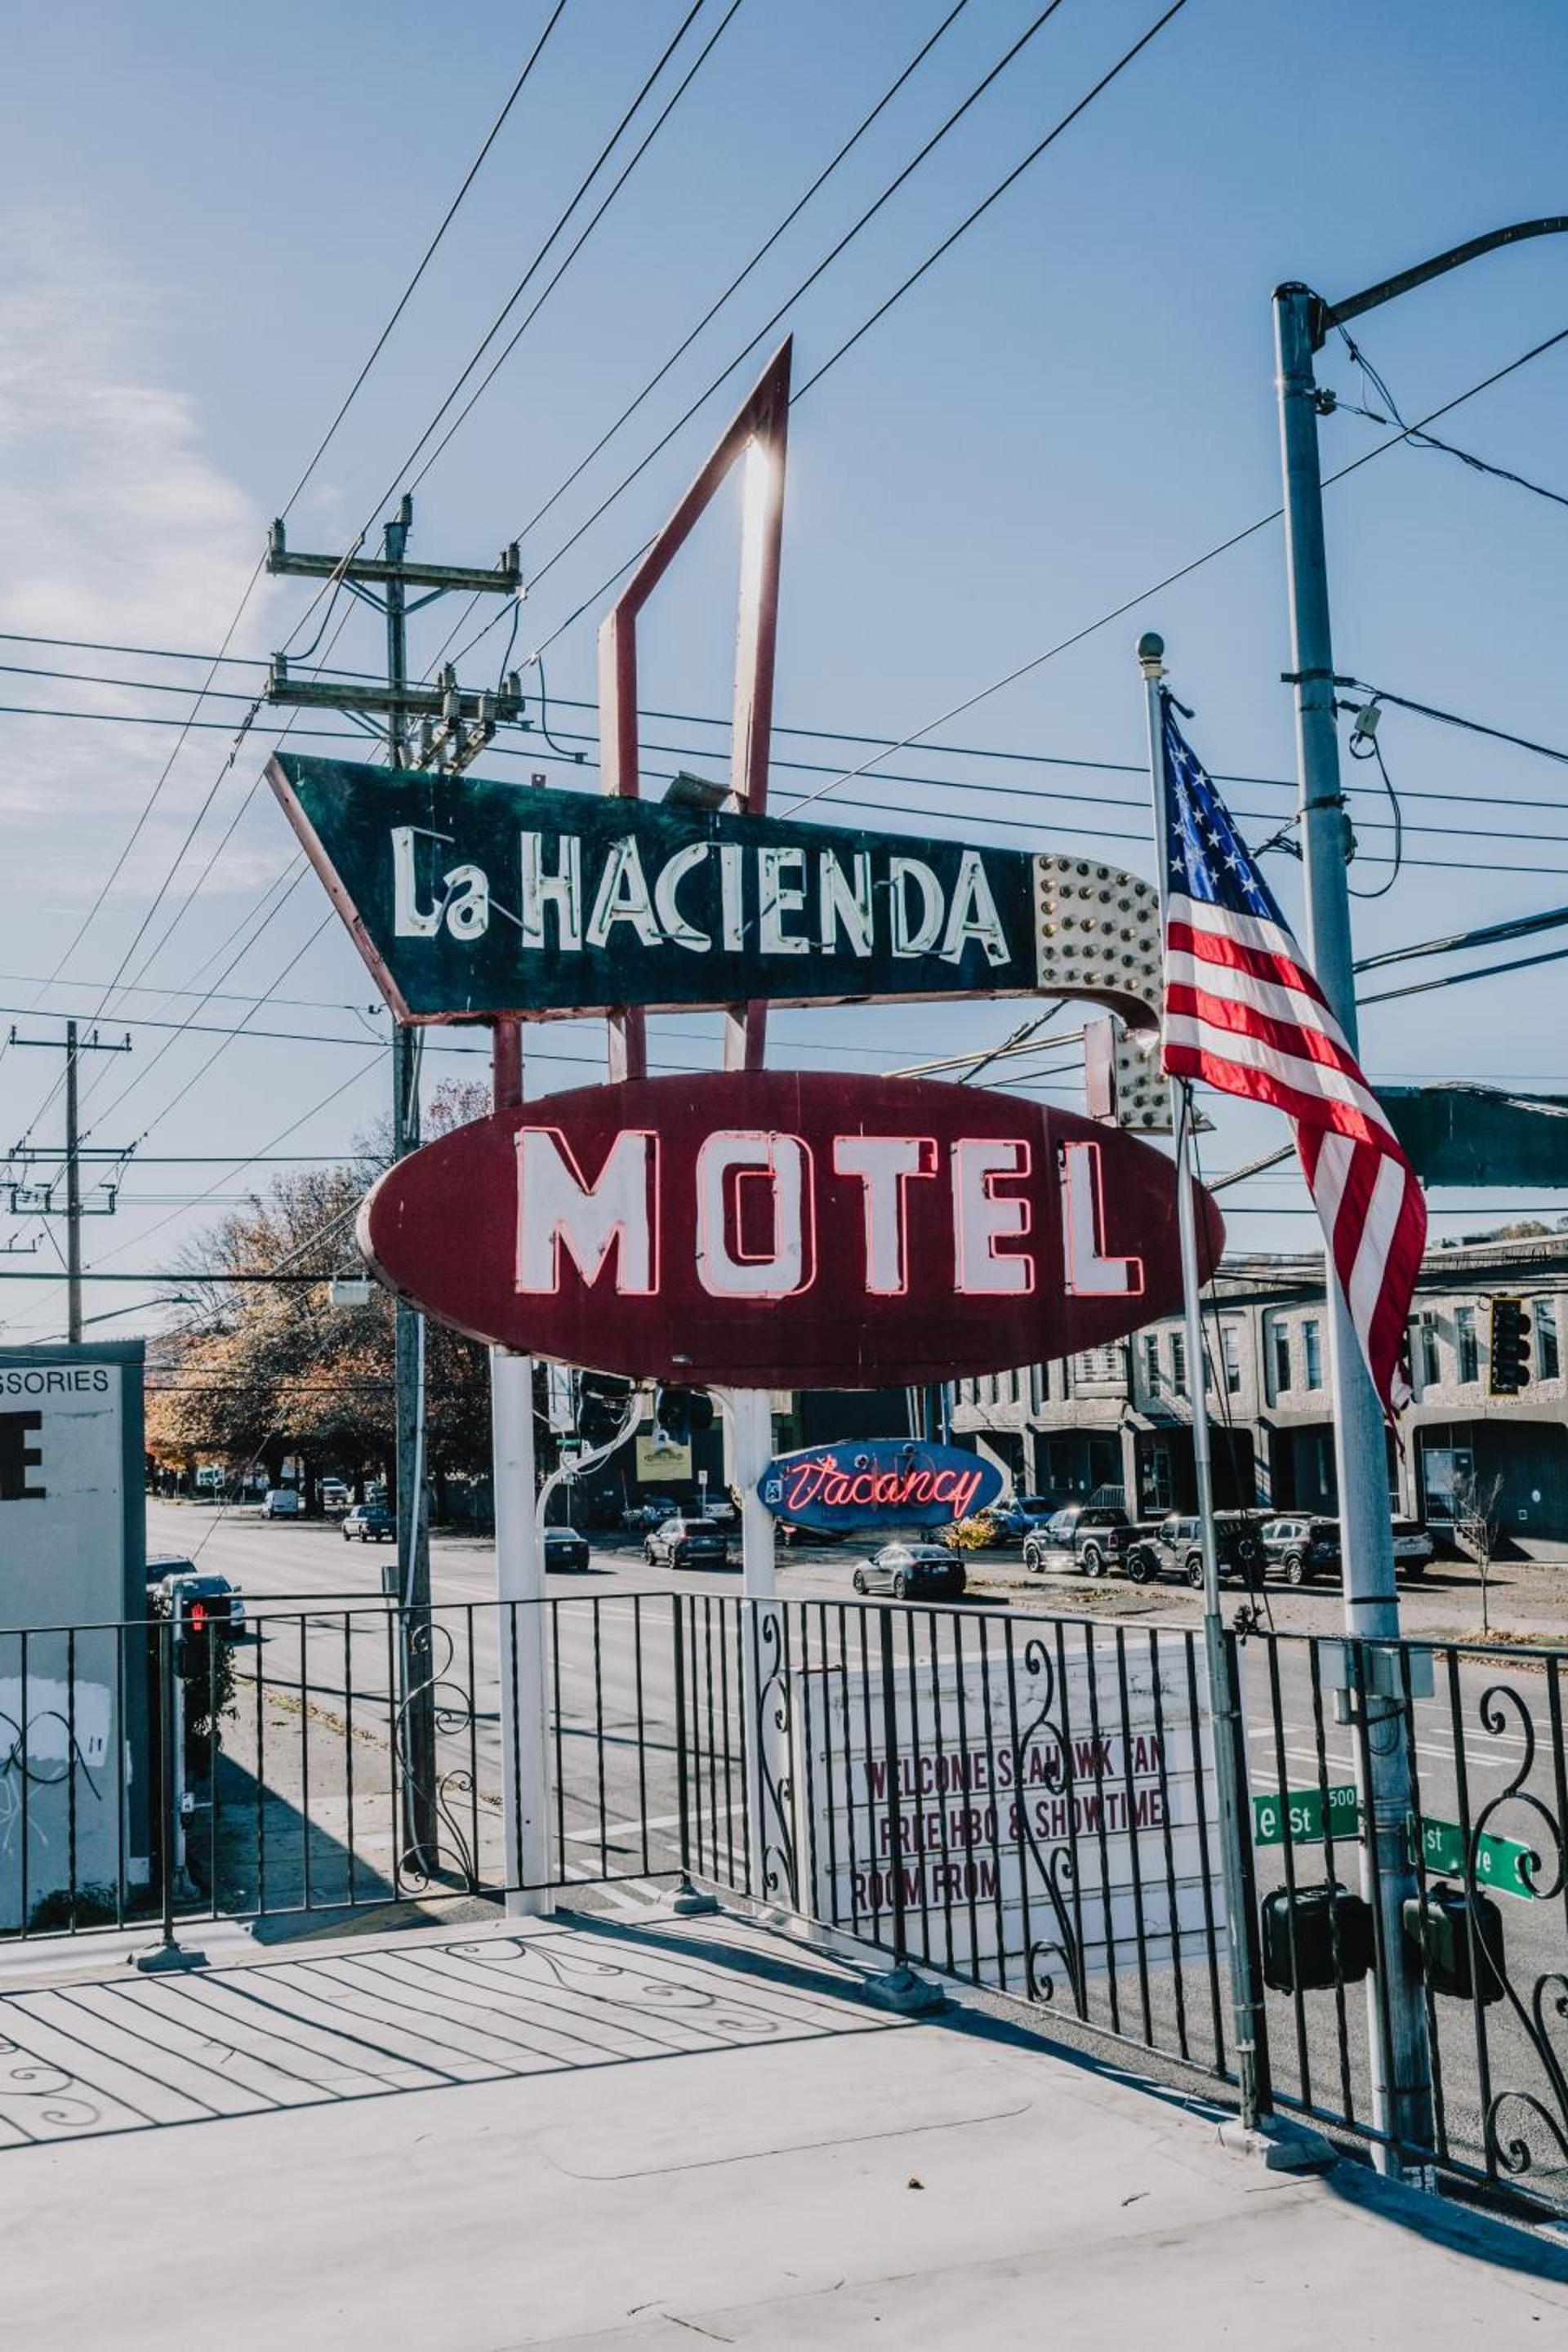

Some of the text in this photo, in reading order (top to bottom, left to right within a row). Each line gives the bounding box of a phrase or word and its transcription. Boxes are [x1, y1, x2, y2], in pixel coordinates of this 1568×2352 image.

[391, 826, 1012, 967] La HACIENDA
[514, 1126, 1144, 1299] MOTEL
[0, 1370, 109, 1395] SORIES
[788, 1461, 982, 1518] Vacancy
[998, 1740, 1114, 1787] SAHWK
[1036, 1788, 1164, 1838] SHOWTIME
[1329, 1789, 1355, 1807] 500
[932, 1860, 999, 1903] FROM
